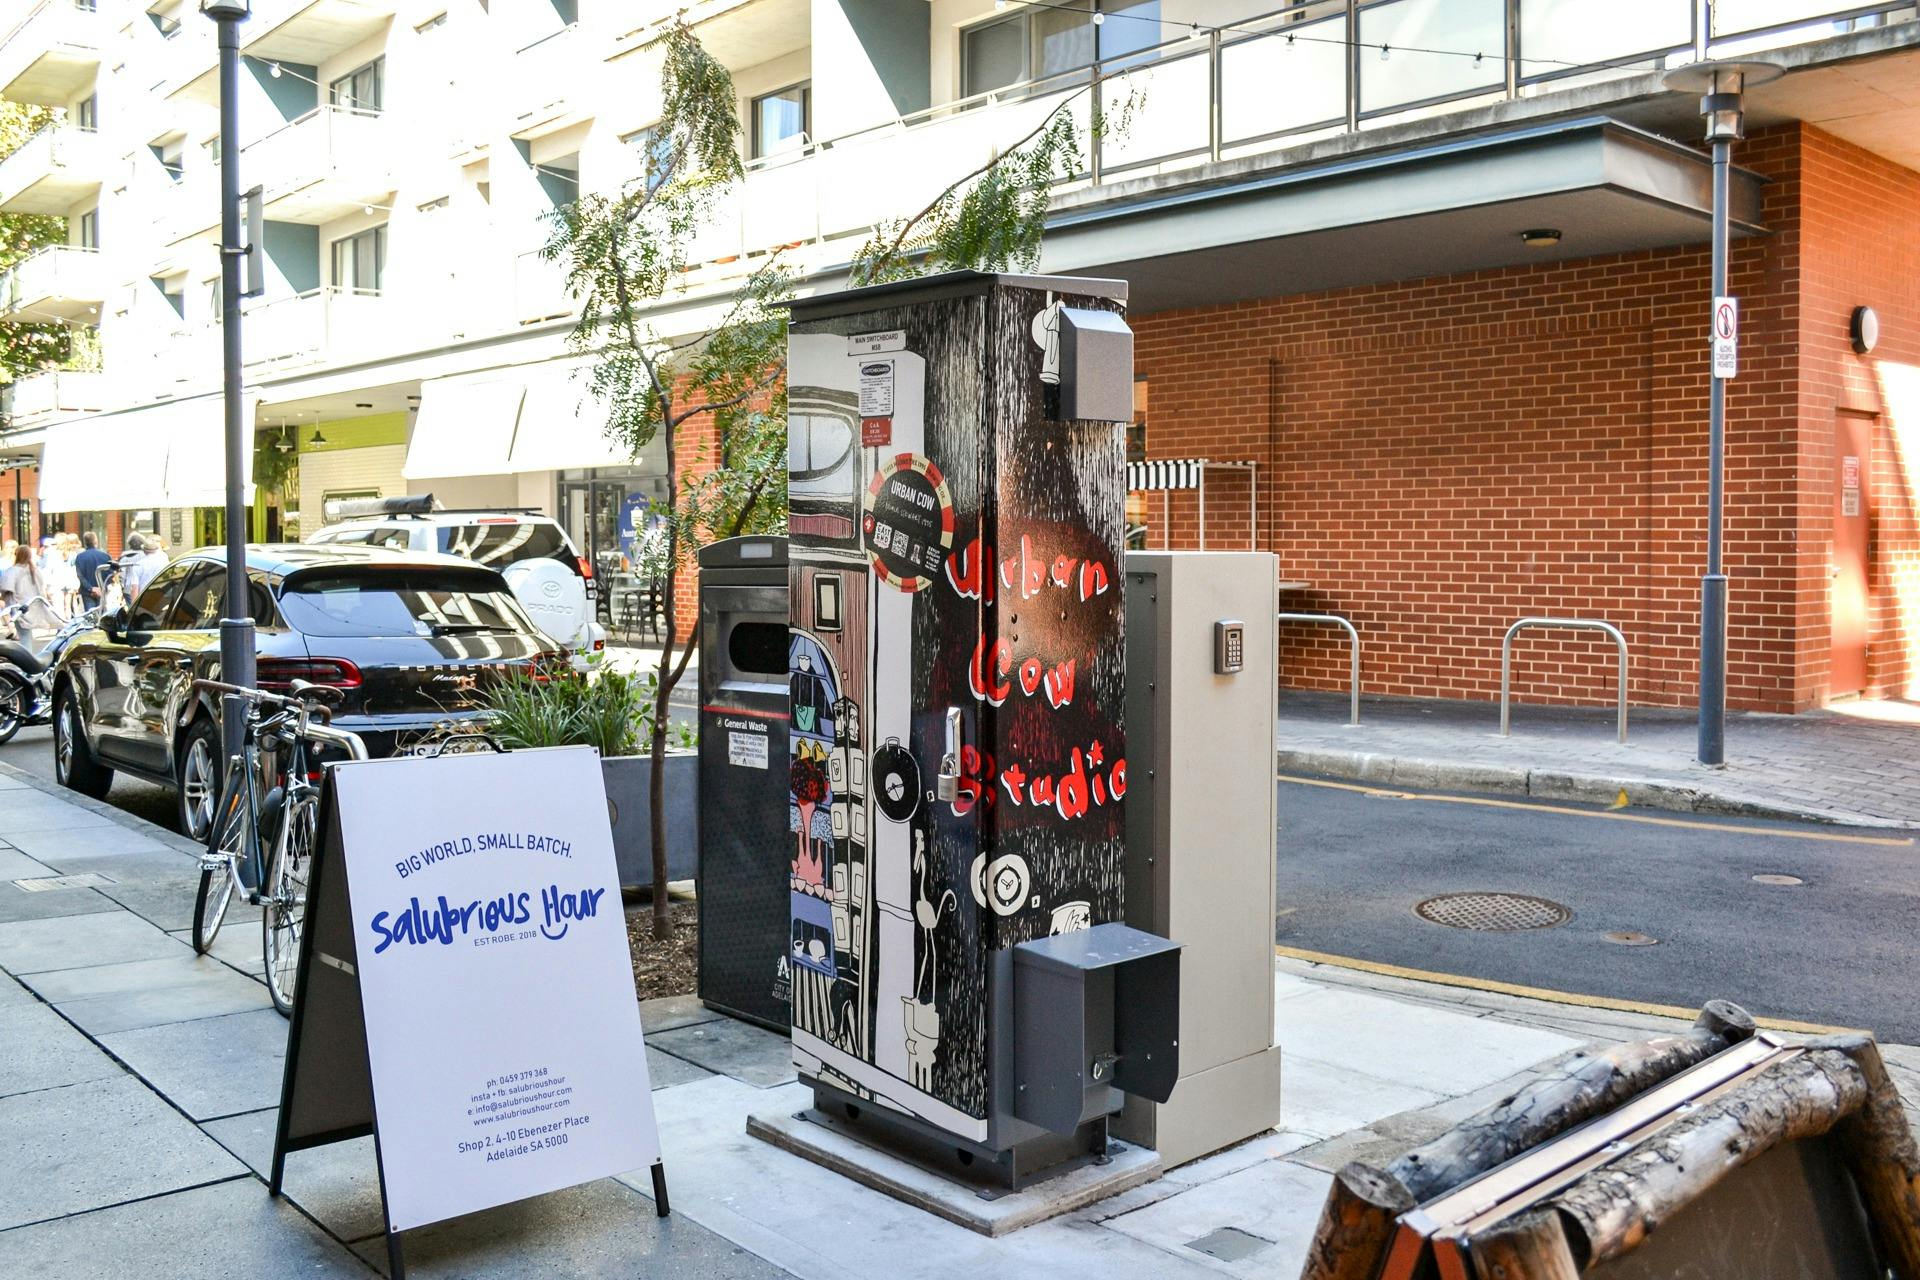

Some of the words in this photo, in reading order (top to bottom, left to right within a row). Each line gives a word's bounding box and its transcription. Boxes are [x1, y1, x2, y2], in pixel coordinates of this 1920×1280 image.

[891, 480, 917, 503] URBAN
[917, 492, 935, 511] COW
[865, 519, 871, 530] 4
[876, 533, 889, 543] END
[878, 524, 891, 536] EAST
[528, 603, 574, 615] PRADO
[968, 634, 1076, 709] Cow
[725, 719, 747, 730] General
[749, 721, 767, 732] Waste
[396, 856, 421, 878] BIG
[420, 837, 476, 865] WORLD,
[477, 833, 524, 850] SMALL
[527, 834, 572, 858] BATCH.
[541, 884, 604, 927] Hour
[474, 937, 491, 947] EST
[518, 930, 537, 940] 2018
[471, 1091, 490, 1103] insta
[508, 1076, 566, 1094] salubrioushour
[500, 1074, 518, 1085] 0459
[520, 1070, 532, 1080] 379
[534, 1068, 548, 1078] 368
[473, 1098, 570, 1126] www.salubrioushour.com
[475, 1086, 572, 1114] info@salubrioushour.com
[458, 1140, 484, 1153] Shop
[496, 1130, 516, 1143] 4-10
[518, 1122, 563, 1139] Ebenezer
[564, 1115, 589, 1128] Place
[487, 1145, 528, 1162] Adelaide
[530, 1140, 543, 1152] SA
[545, 1133, 568, 1148] 5000
